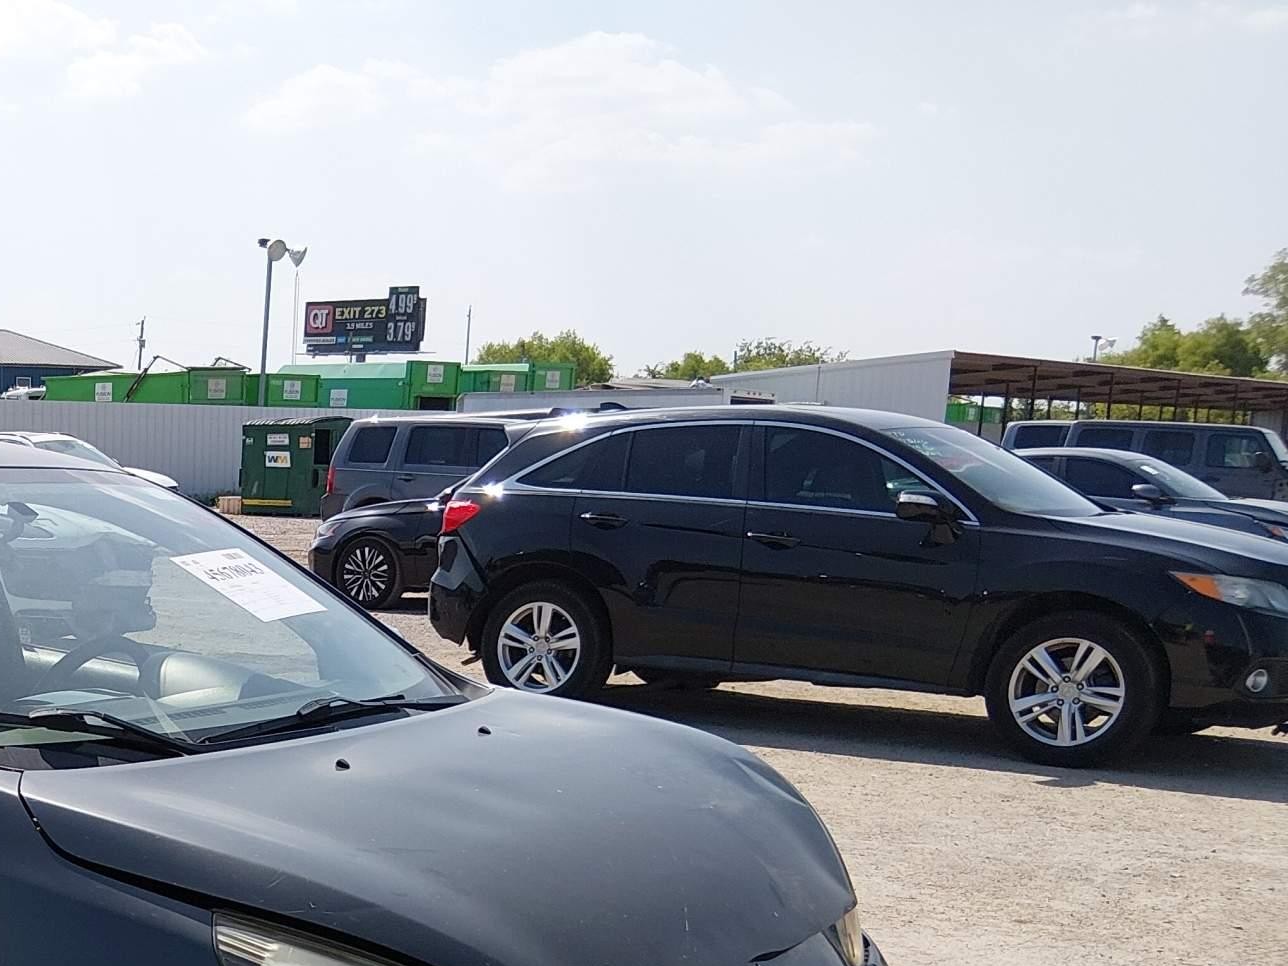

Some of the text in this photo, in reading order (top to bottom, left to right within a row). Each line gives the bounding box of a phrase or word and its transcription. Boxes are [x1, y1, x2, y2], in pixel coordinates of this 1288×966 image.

[309, 309, 328, 329] QT
[335, 306, 386, 320] EXIT 273
[267, 455, 289, 464] WM
[203, 562, 264, 581] 45678043
